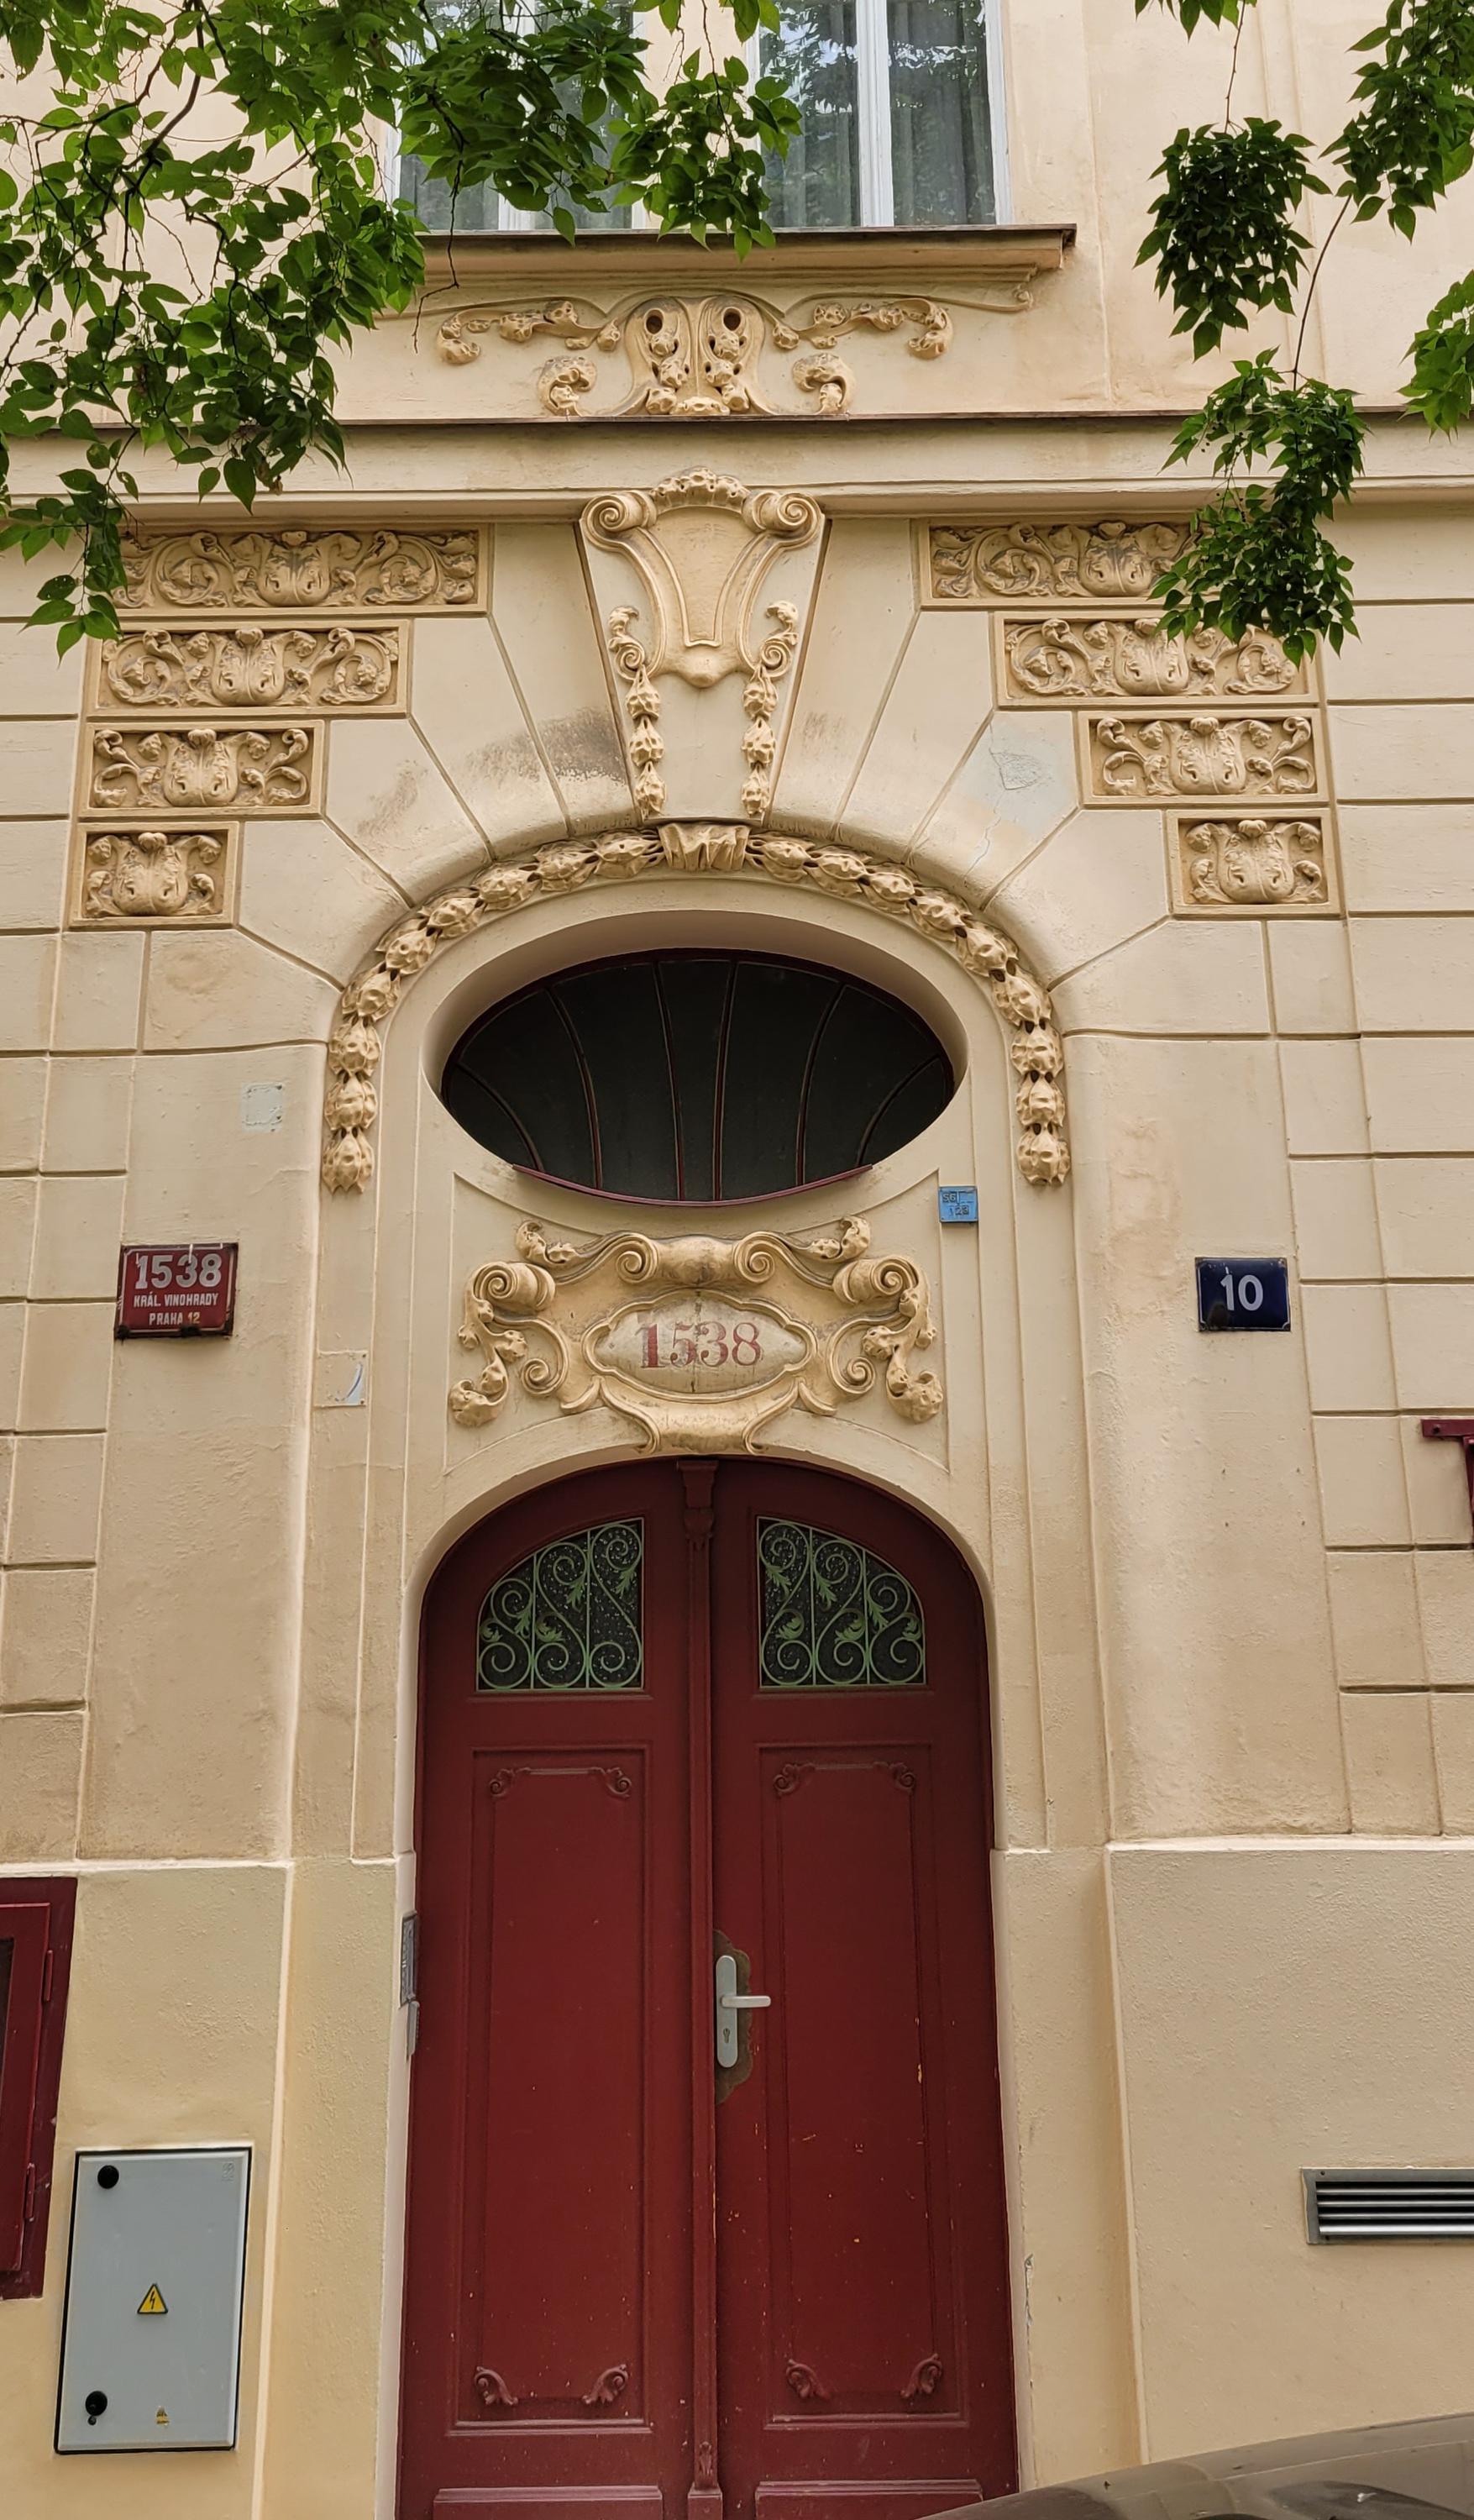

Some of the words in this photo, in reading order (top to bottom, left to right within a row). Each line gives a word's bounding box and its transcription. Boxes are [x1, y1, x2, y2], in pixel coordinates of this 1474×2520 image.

[134, 1252, 223, 1289] 1538
[134, 1291, 162, 1308] KRÁL.
[164, 1293, 219, 1307] VINOHRADY
[1220, 1274, 1264, 1311] 10
[149, 1312, 183, 1326] PRAHA
[187, 1311, 201, 1324] 12
[634, 1320, 762, 1369] 1538
